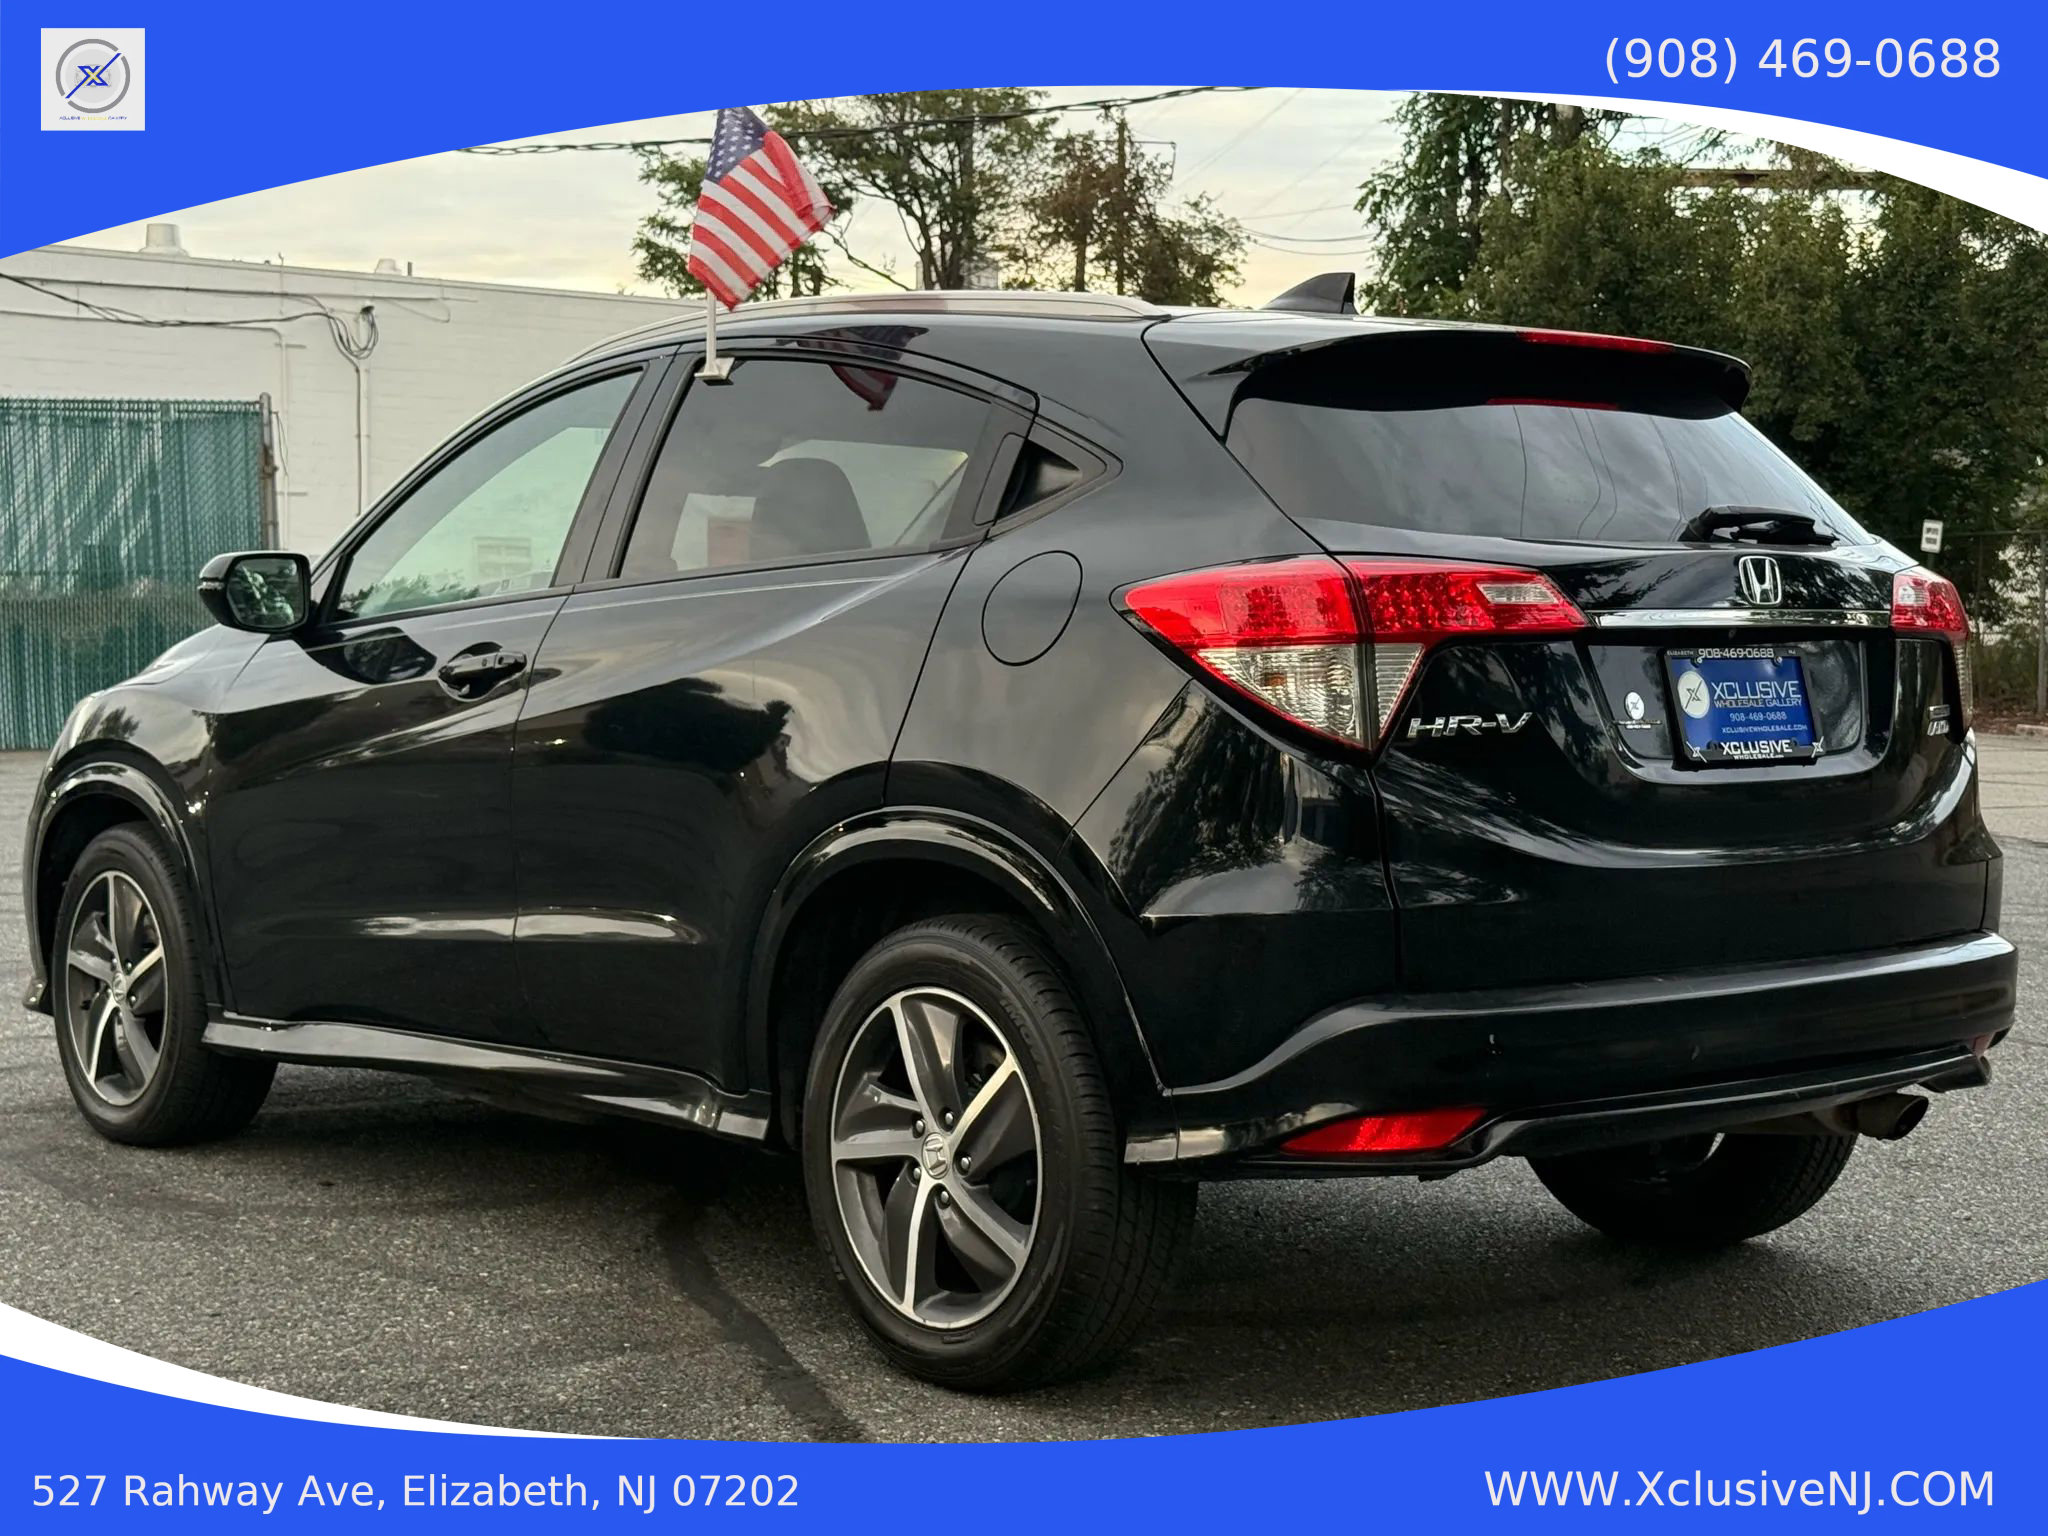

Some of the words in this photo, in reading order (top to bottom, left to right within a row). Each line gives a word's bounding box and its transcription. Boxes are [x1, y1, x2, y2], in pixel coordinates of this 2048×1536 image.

[1697, 647, 1775, 659] 908-469-0688
[1711, 680, 1802, 700] XCLUSIVE
[1713, 699, 1765, 709] WHOLESALE
[1765, 698, 1803, 708] GALLERY
[1729, 711, 1788, 723] 908-469-0688
[1406, 711, 1534, 739] HR-V
[1720, 739, 1793, 756] XCLUSIVE
